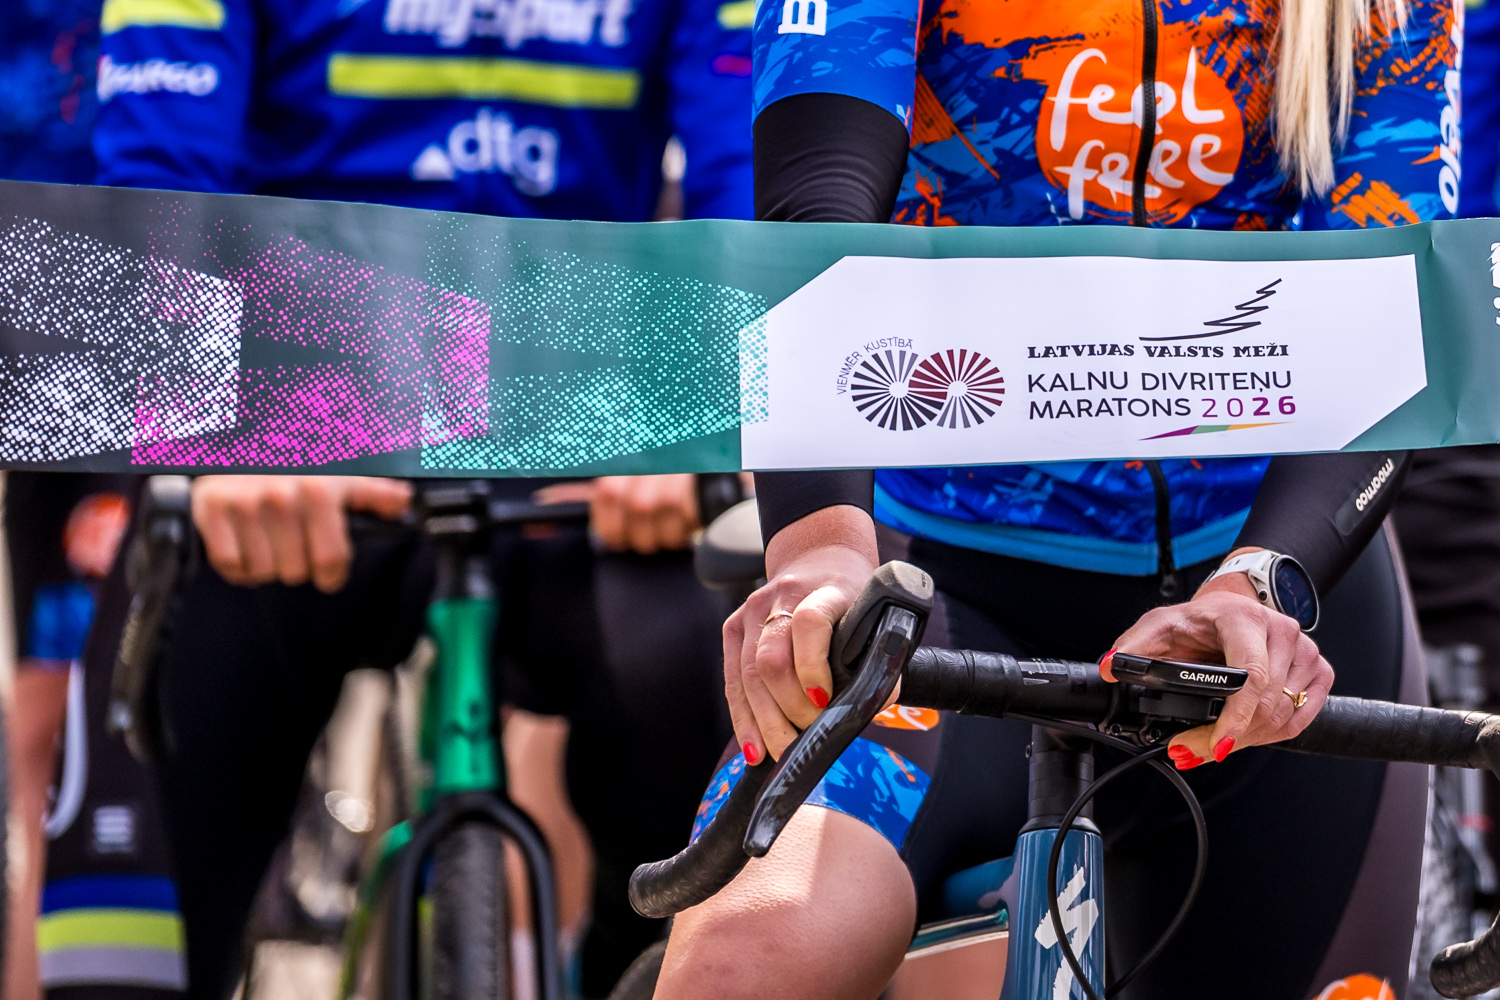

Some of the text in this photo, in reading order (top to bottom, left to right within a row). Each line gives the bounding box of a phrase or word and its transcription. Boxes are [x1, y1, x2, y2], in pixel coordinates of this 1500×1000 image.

[1027, 342, 1290, 359] LATVIJAS VALSTS MEŽI
[1027, 370, 1293, 394] KALNU DIVRITEŅU
[1028, 395, 1297, 420] MARATONS 2026
[1355, 457, 1395, 512] moomoo
[1179, 669, 1229, 685] GARMIN
